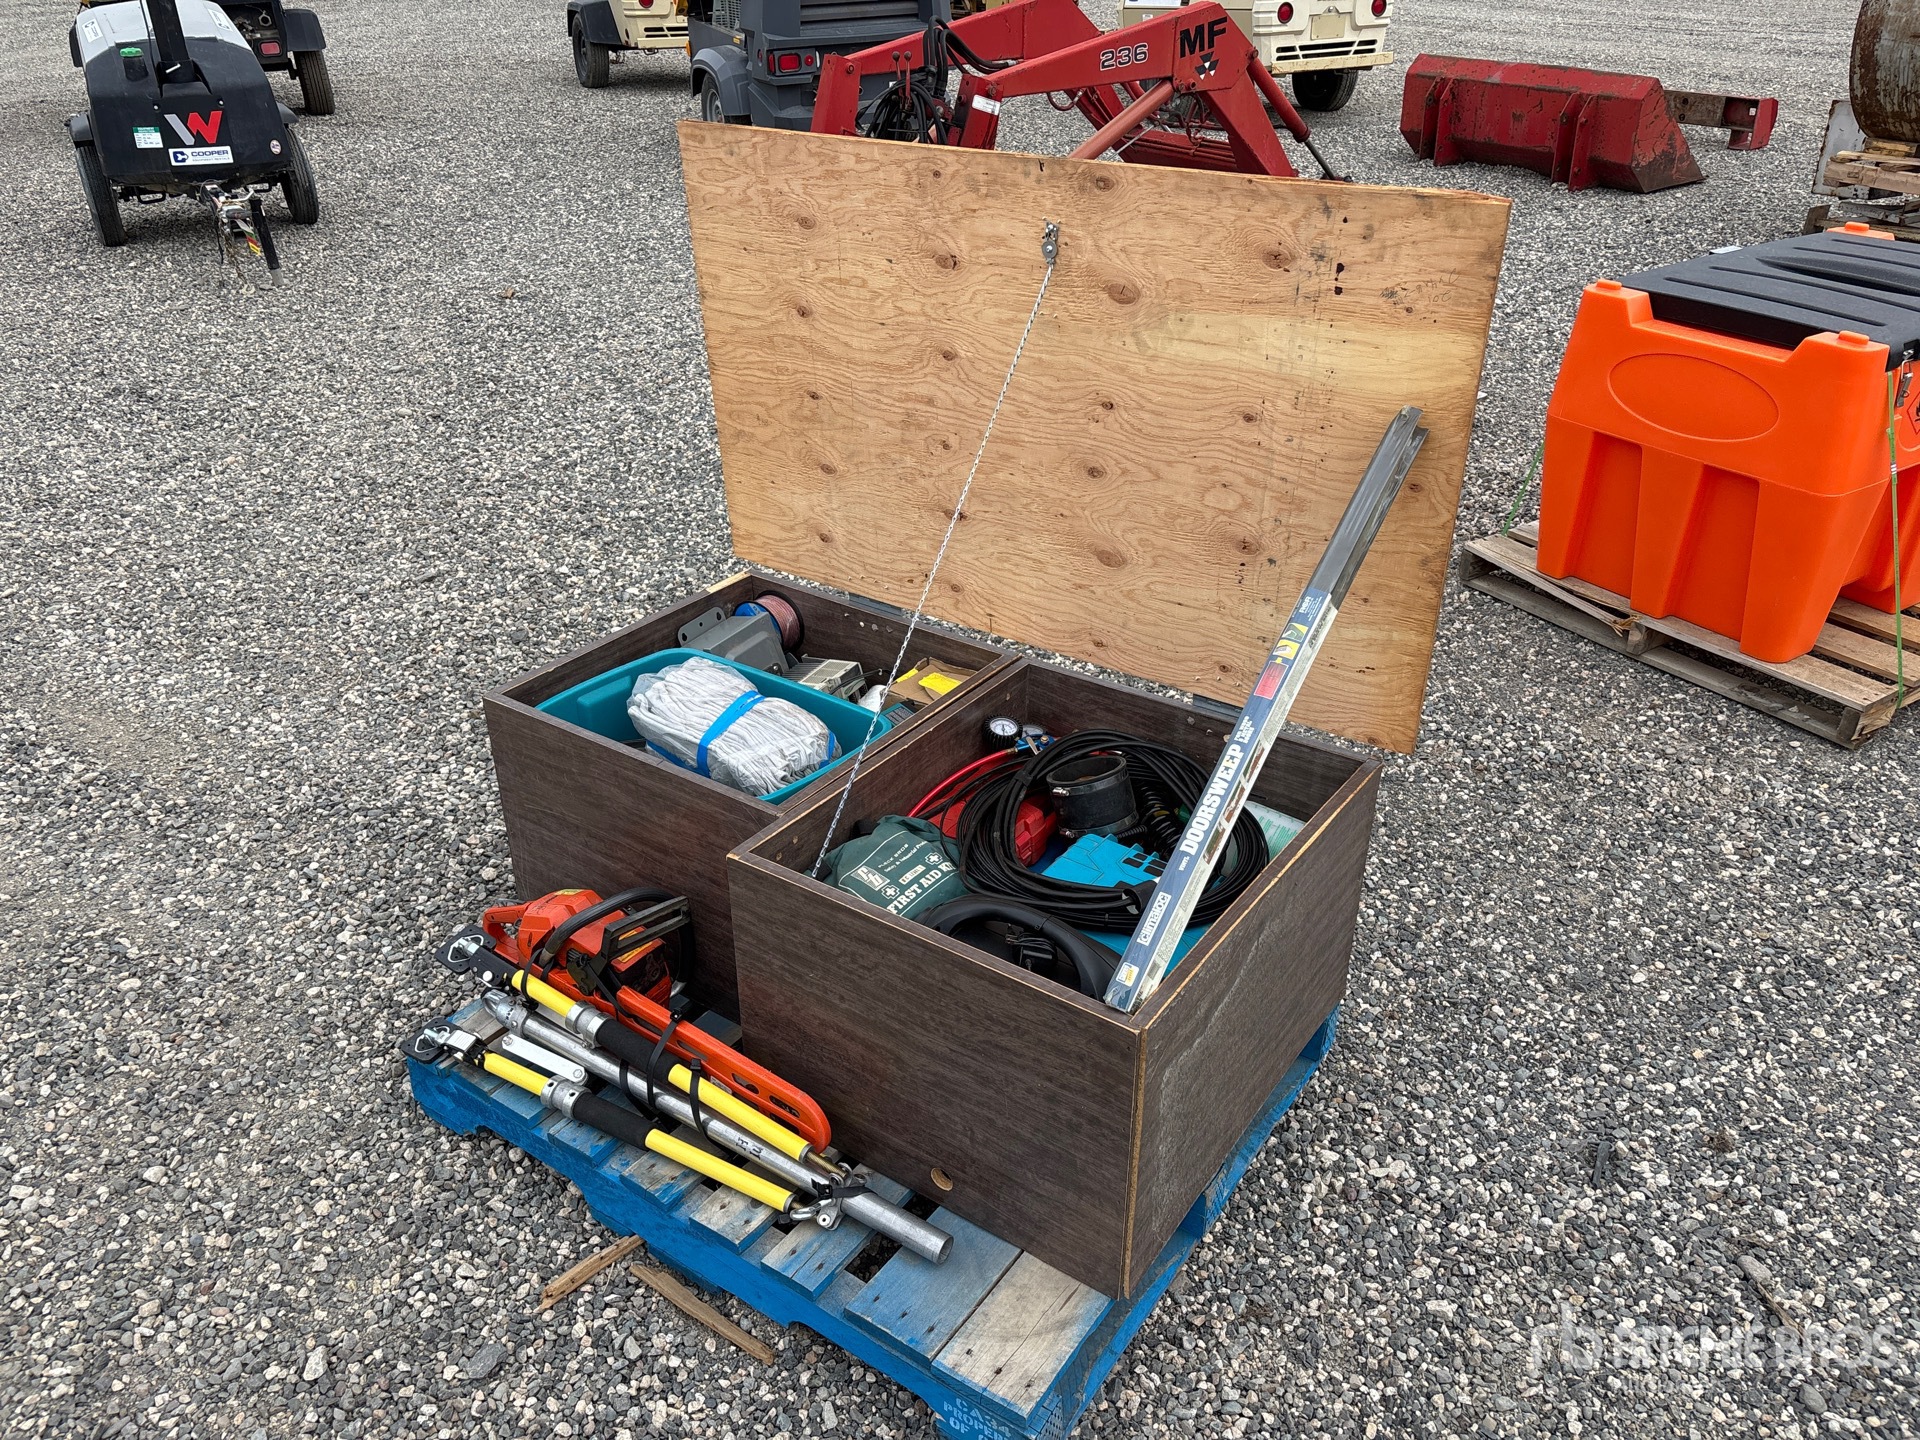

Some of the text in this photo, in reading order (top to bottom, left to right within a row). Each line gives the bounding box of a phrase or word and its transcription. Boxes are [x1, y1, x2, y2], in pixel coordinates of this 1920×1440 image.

[1099, 43, 1149, 72] 236
[1179, 17, 1228, 59] MF
[191, 149, 229, 157] COOPER
[1180, 743, 1245, 856] DOORSWEEP
[1179, 856, 1190, 871] VINYL
[886, 883, 923, 915] FIRST
[919, 869, 943, 888] AID
[1140, 892, 1170, 944] climaloc
[943, 1401, 1009, 1440] PROPER
[949, 1417, 971, 1434] OF
